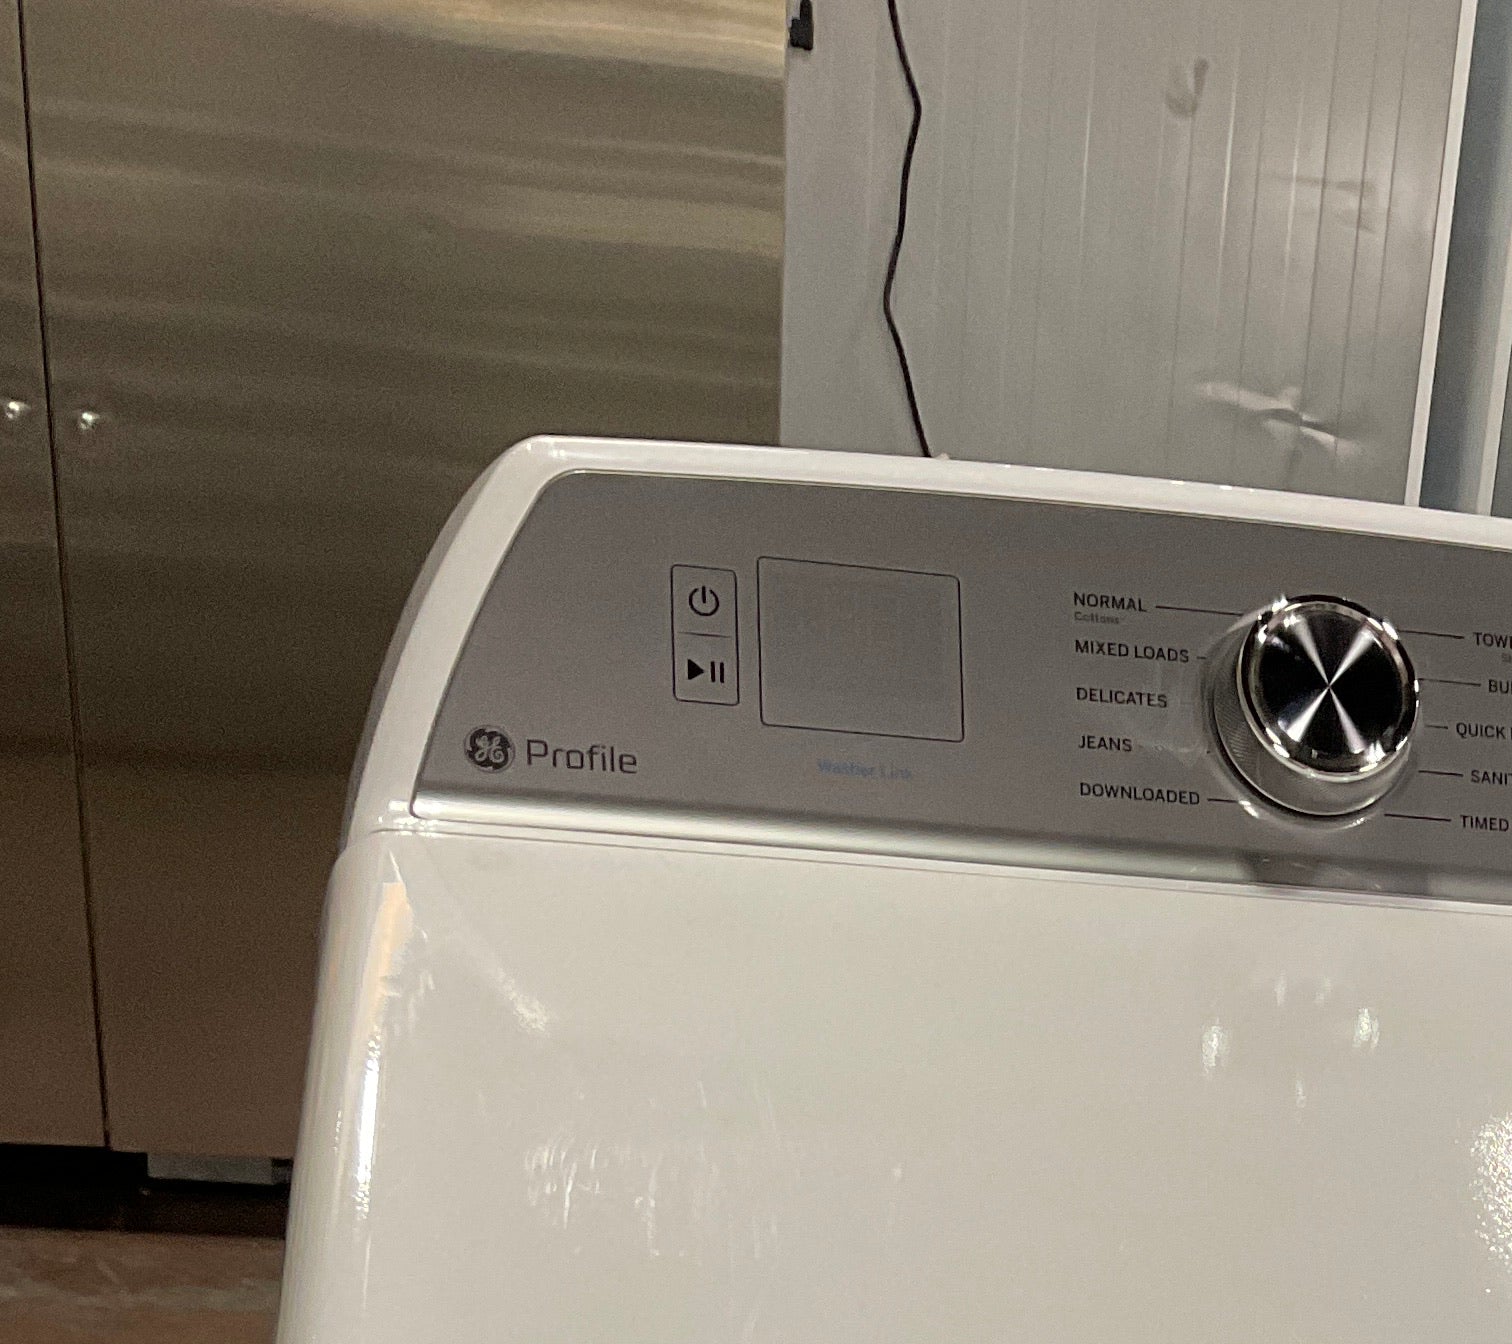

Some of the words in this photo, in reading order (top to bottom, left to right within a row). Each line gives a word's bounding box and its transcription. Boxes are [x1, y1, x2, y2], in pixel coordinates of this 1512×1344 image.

[1073, 591, 1148, 613] NORMAL
[1075, 639, 1130, 657] MIXED
[1134, 645, 1189, 663] LOADS
[1076, 687, 1168, 709] DELICATES
[1456, 722, 1506, 741] QUICK
[1078, 735, 1133, 753] JEANS
[526, 738, 638, 775] Profile
[1080, 782, 1200, 806] DOWNLOADED
[1460, 814, 1510, 833] TIMED
